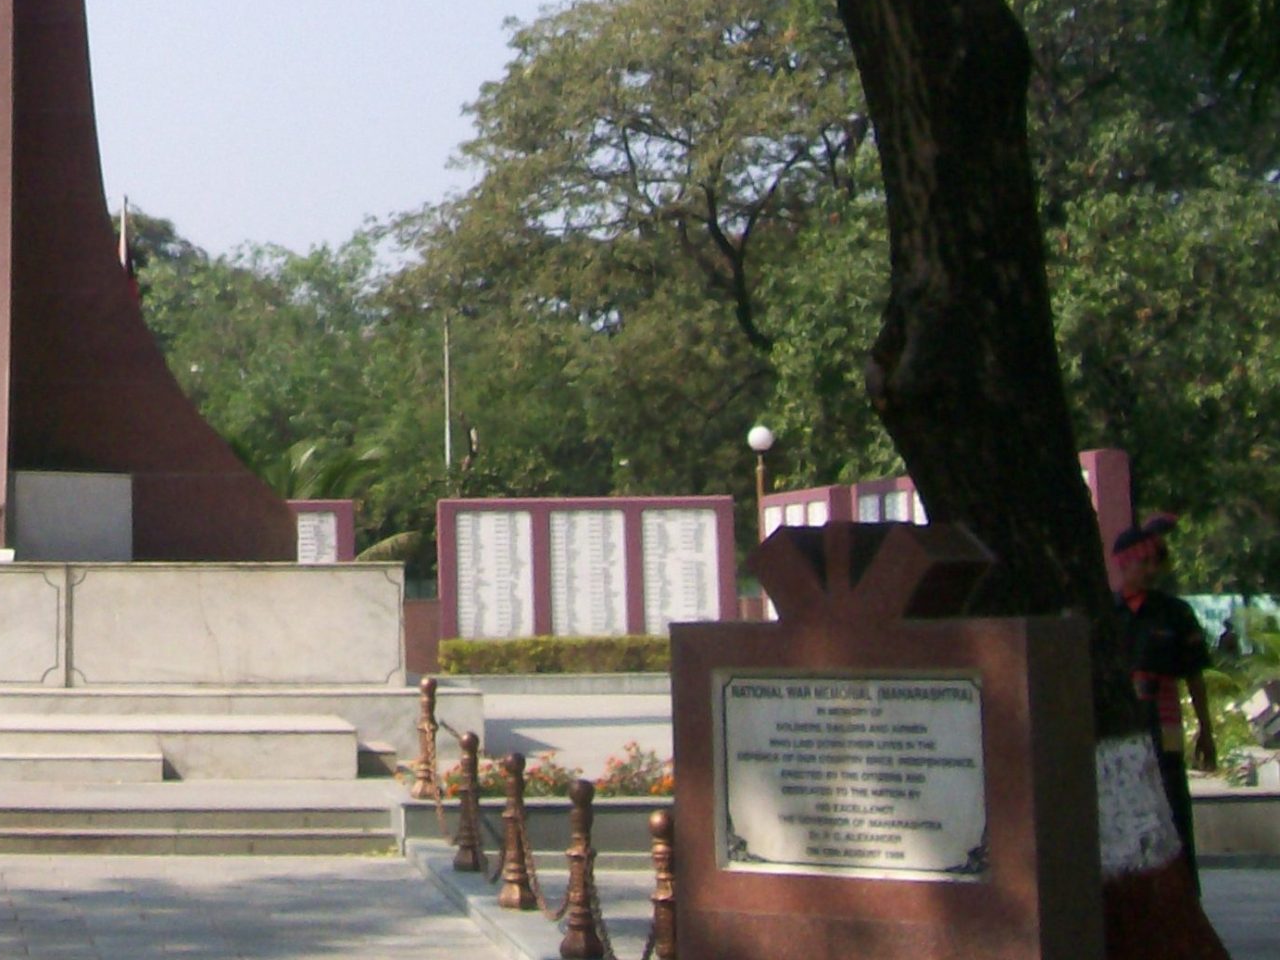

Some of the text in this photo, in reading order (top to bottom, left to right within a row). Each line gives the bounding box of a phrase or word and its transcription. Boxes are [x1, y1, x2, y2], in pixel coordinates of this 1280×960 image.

[732, 686, 783, 699] NATIONAL
[786, 686, 810, 699] WAR
[814, 686, 872, 700] MEMORIAL
[828, 707, 867, 716] MEMORY
[869, 724, 889, 732] AND
[877, 741, 902, 750] LIVES
[918, 742, 936, 750] THE
[840, 771, 859, 780] THE
[906, 774, 926, 783] AND
[850, 788, 868, 798] THE
